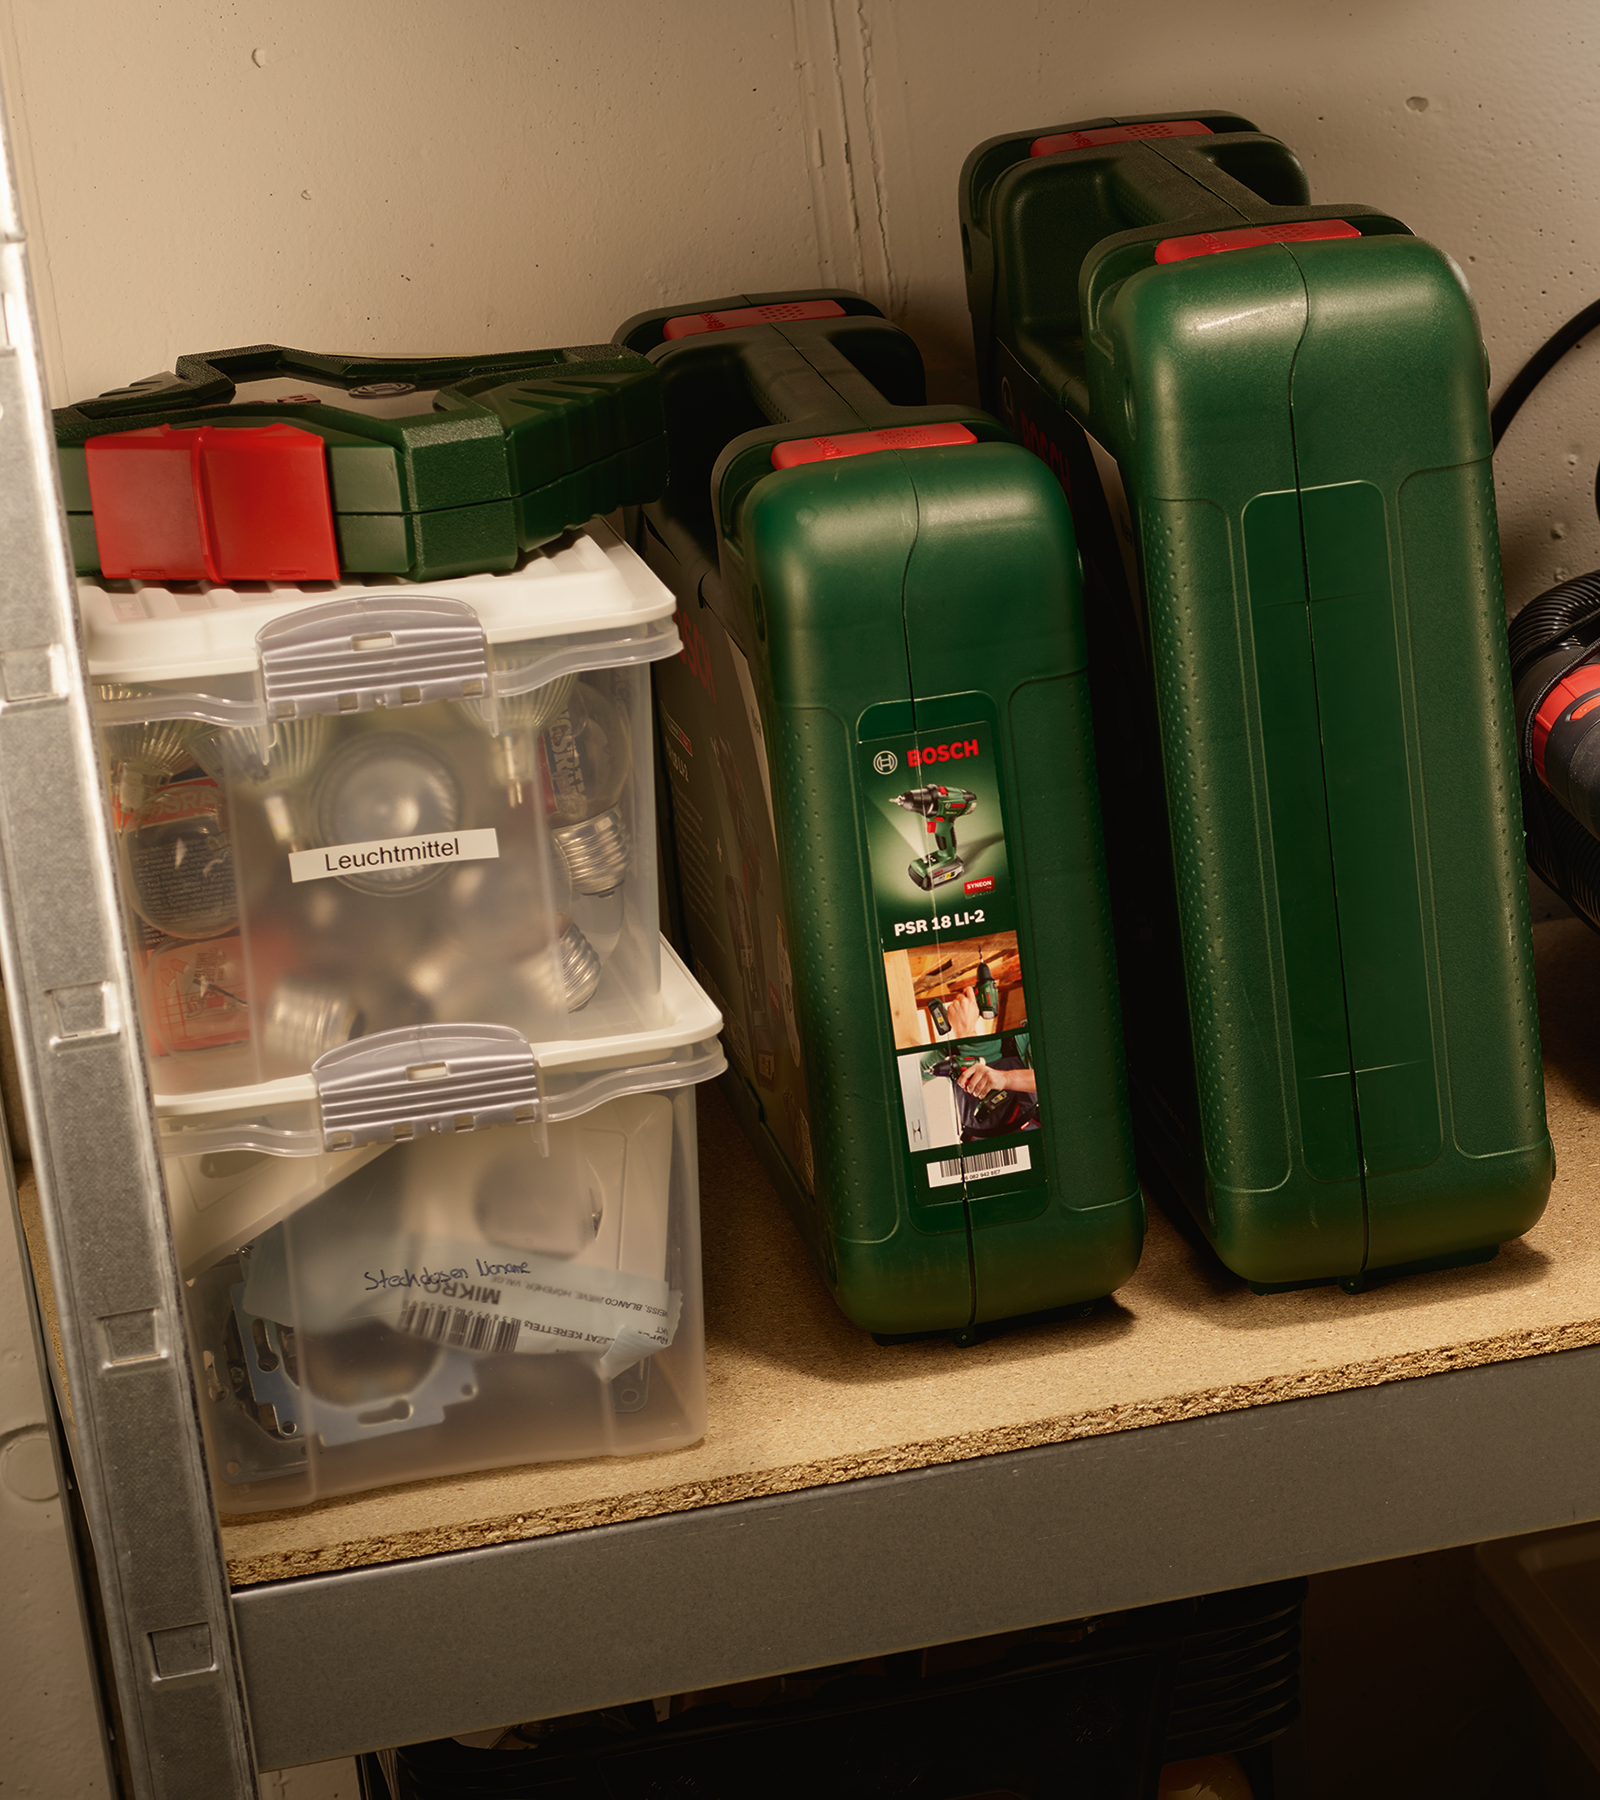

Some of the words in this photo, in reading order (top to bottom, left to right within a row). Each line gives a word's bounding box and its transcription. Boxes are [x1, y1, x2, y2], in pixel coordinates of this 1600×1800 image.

[907, 739, 980, 768] BOSCH
[325, 837, 460, 872] Leuchtmittel
[966, 880, 992, 890] SYNEON
[894, 919, 928, 937] PSR
[931, 915, 952, 930] 18
[954, 909, 986, 927] LI-2
[364, 1266, 469, 1291] Steckdosen
[423, 1280, 502, 1305] MIKRO
[528, 1321, 583, 1340] KERETTEL
